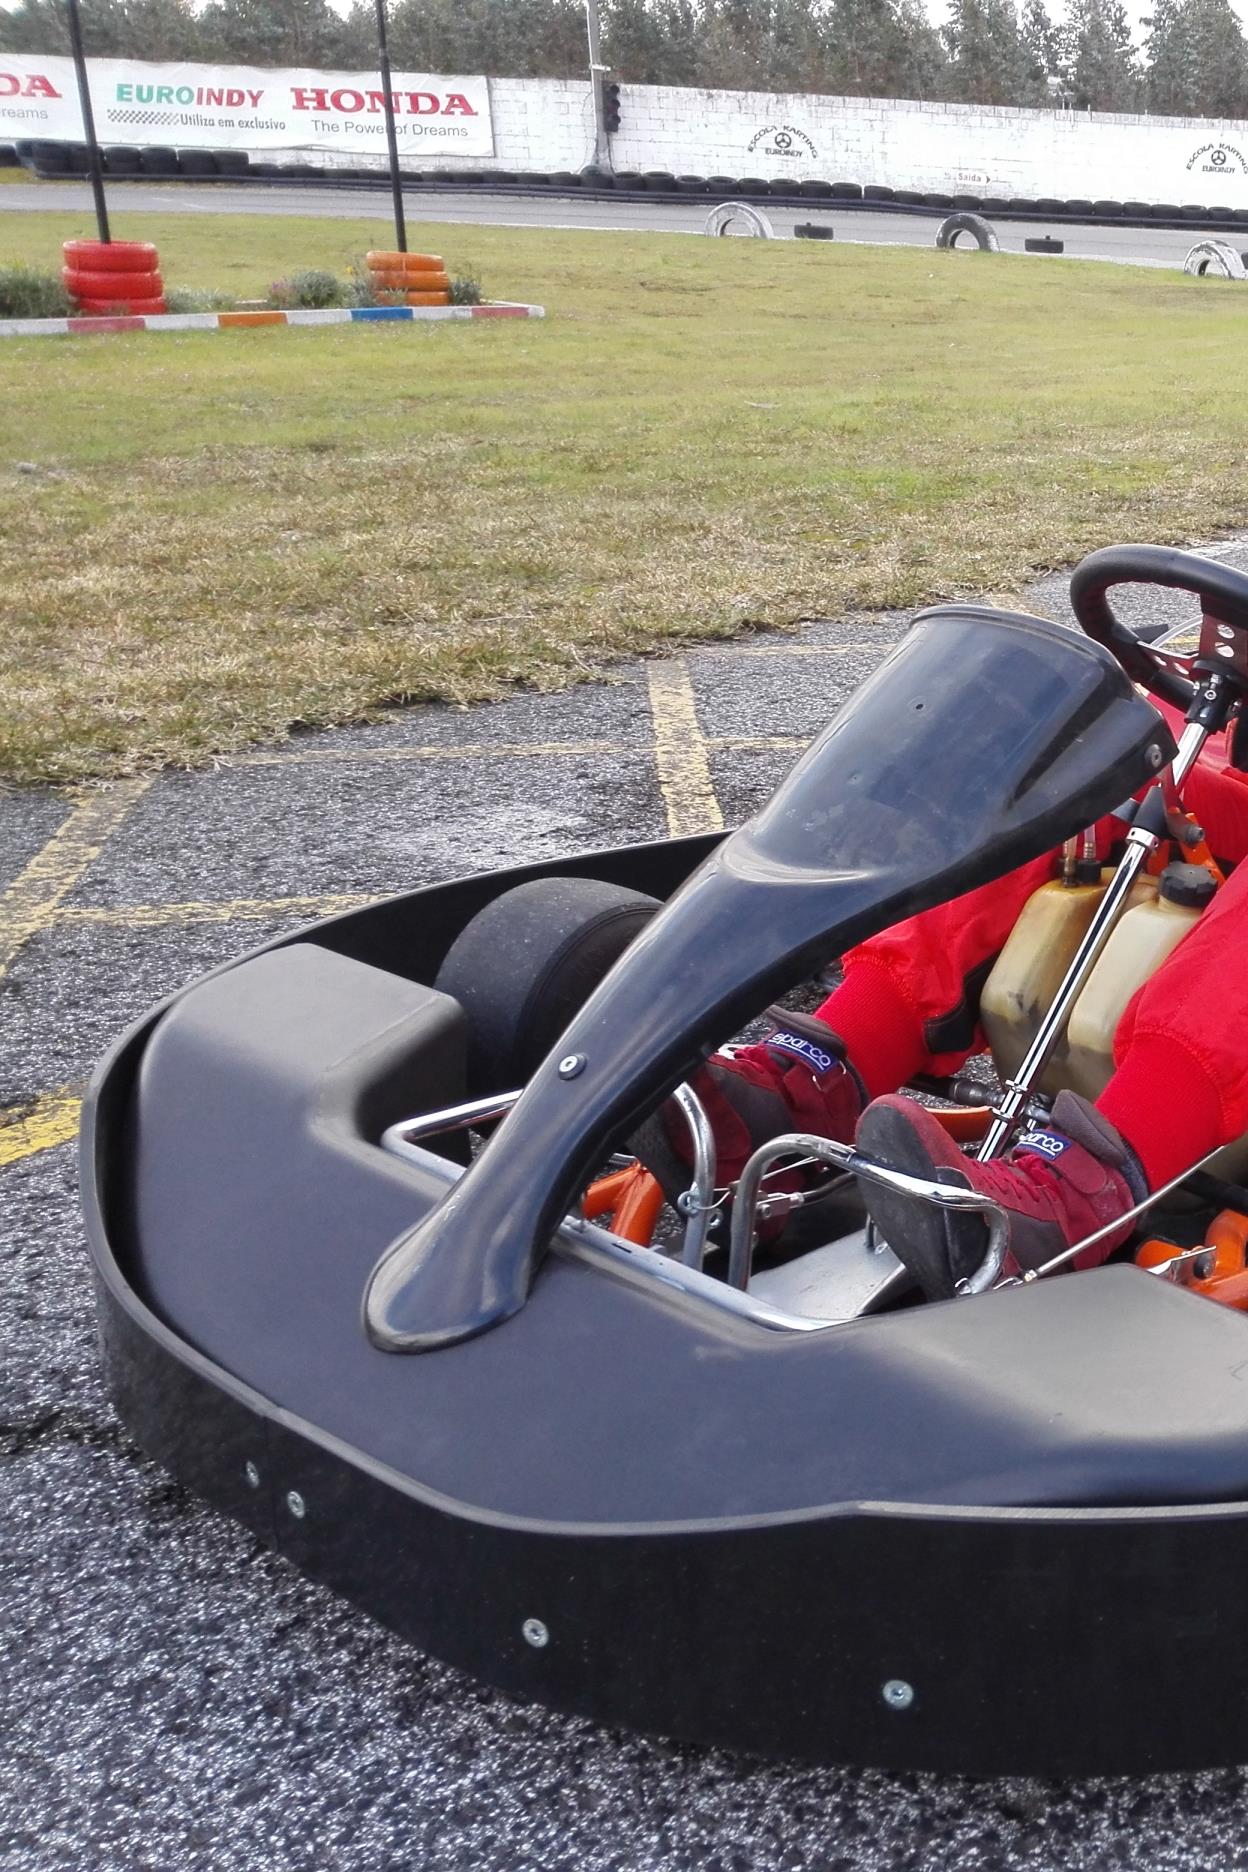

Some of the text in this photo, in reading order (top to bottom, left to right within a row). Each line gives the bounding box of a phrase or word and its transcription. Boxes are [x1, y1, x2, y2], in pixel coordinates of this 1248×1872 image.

[116, 84, 264, 108] EUROINDY
[290, 87, 479, 116] HONDA
[0, 108, 48, 119] reams
[180, 114, 286, 130] Utiliza em exclusivo
[311, 119, 468, 136] The Powe of Dreams
[748, 125, 818, 158] ESCOLA KARTING
[765, 147, 803, 157] EUROINDY
[1186, 143, 1248, 174] ESCOLA KARTING
[772, 1033, 831, 1067] sparco
